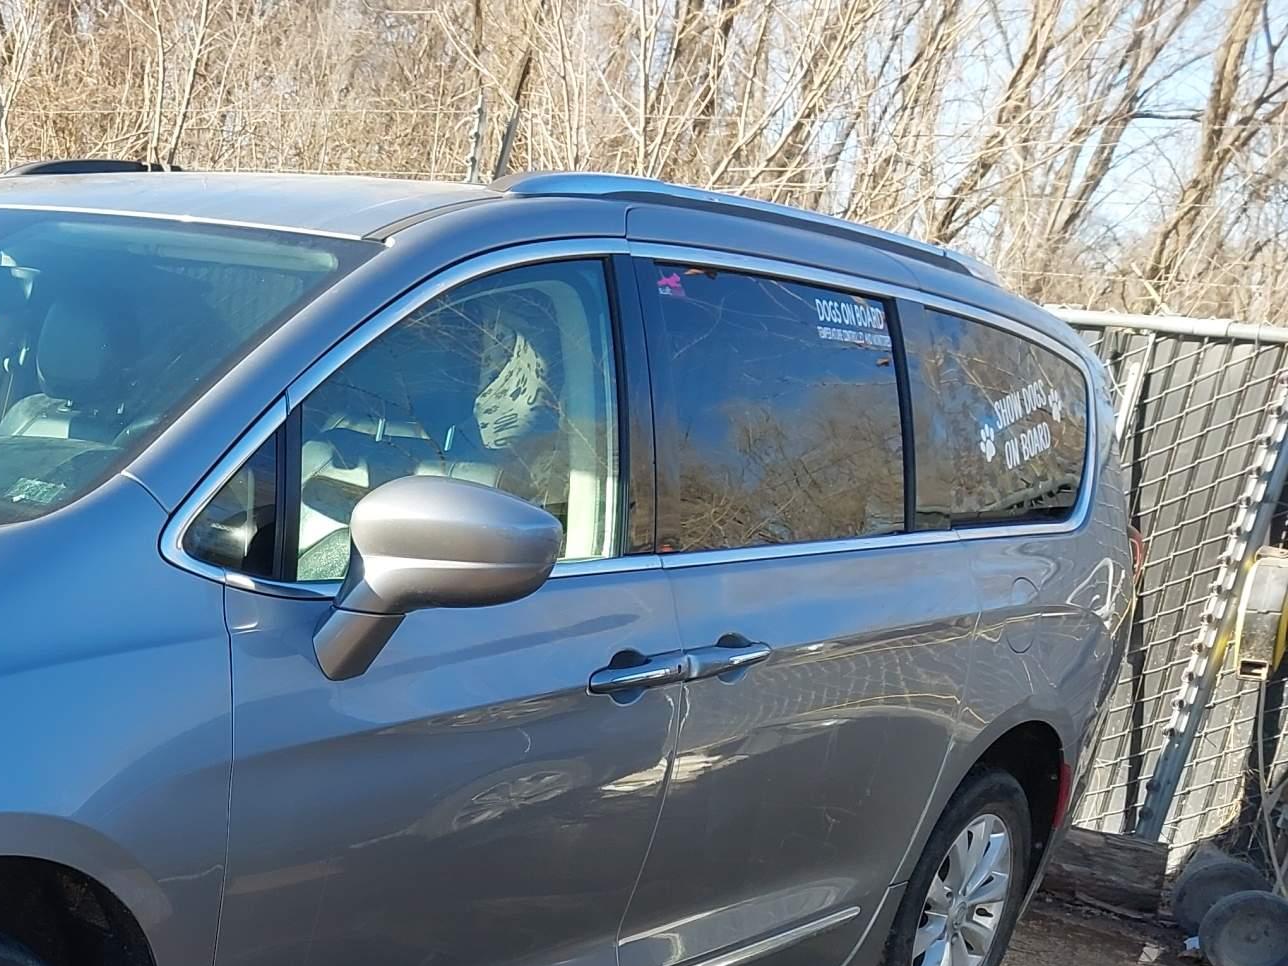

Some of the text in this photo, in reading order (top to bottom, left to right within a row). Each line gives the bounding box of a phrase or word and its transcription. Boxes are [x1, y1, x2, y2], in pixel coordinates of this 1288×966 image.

[815, 299, 884, 330] DOGS ON BOARD
[993, 379, 1047, 430] SHOW DOGS
[1004, 421, 1051, 470] ON BOARD
